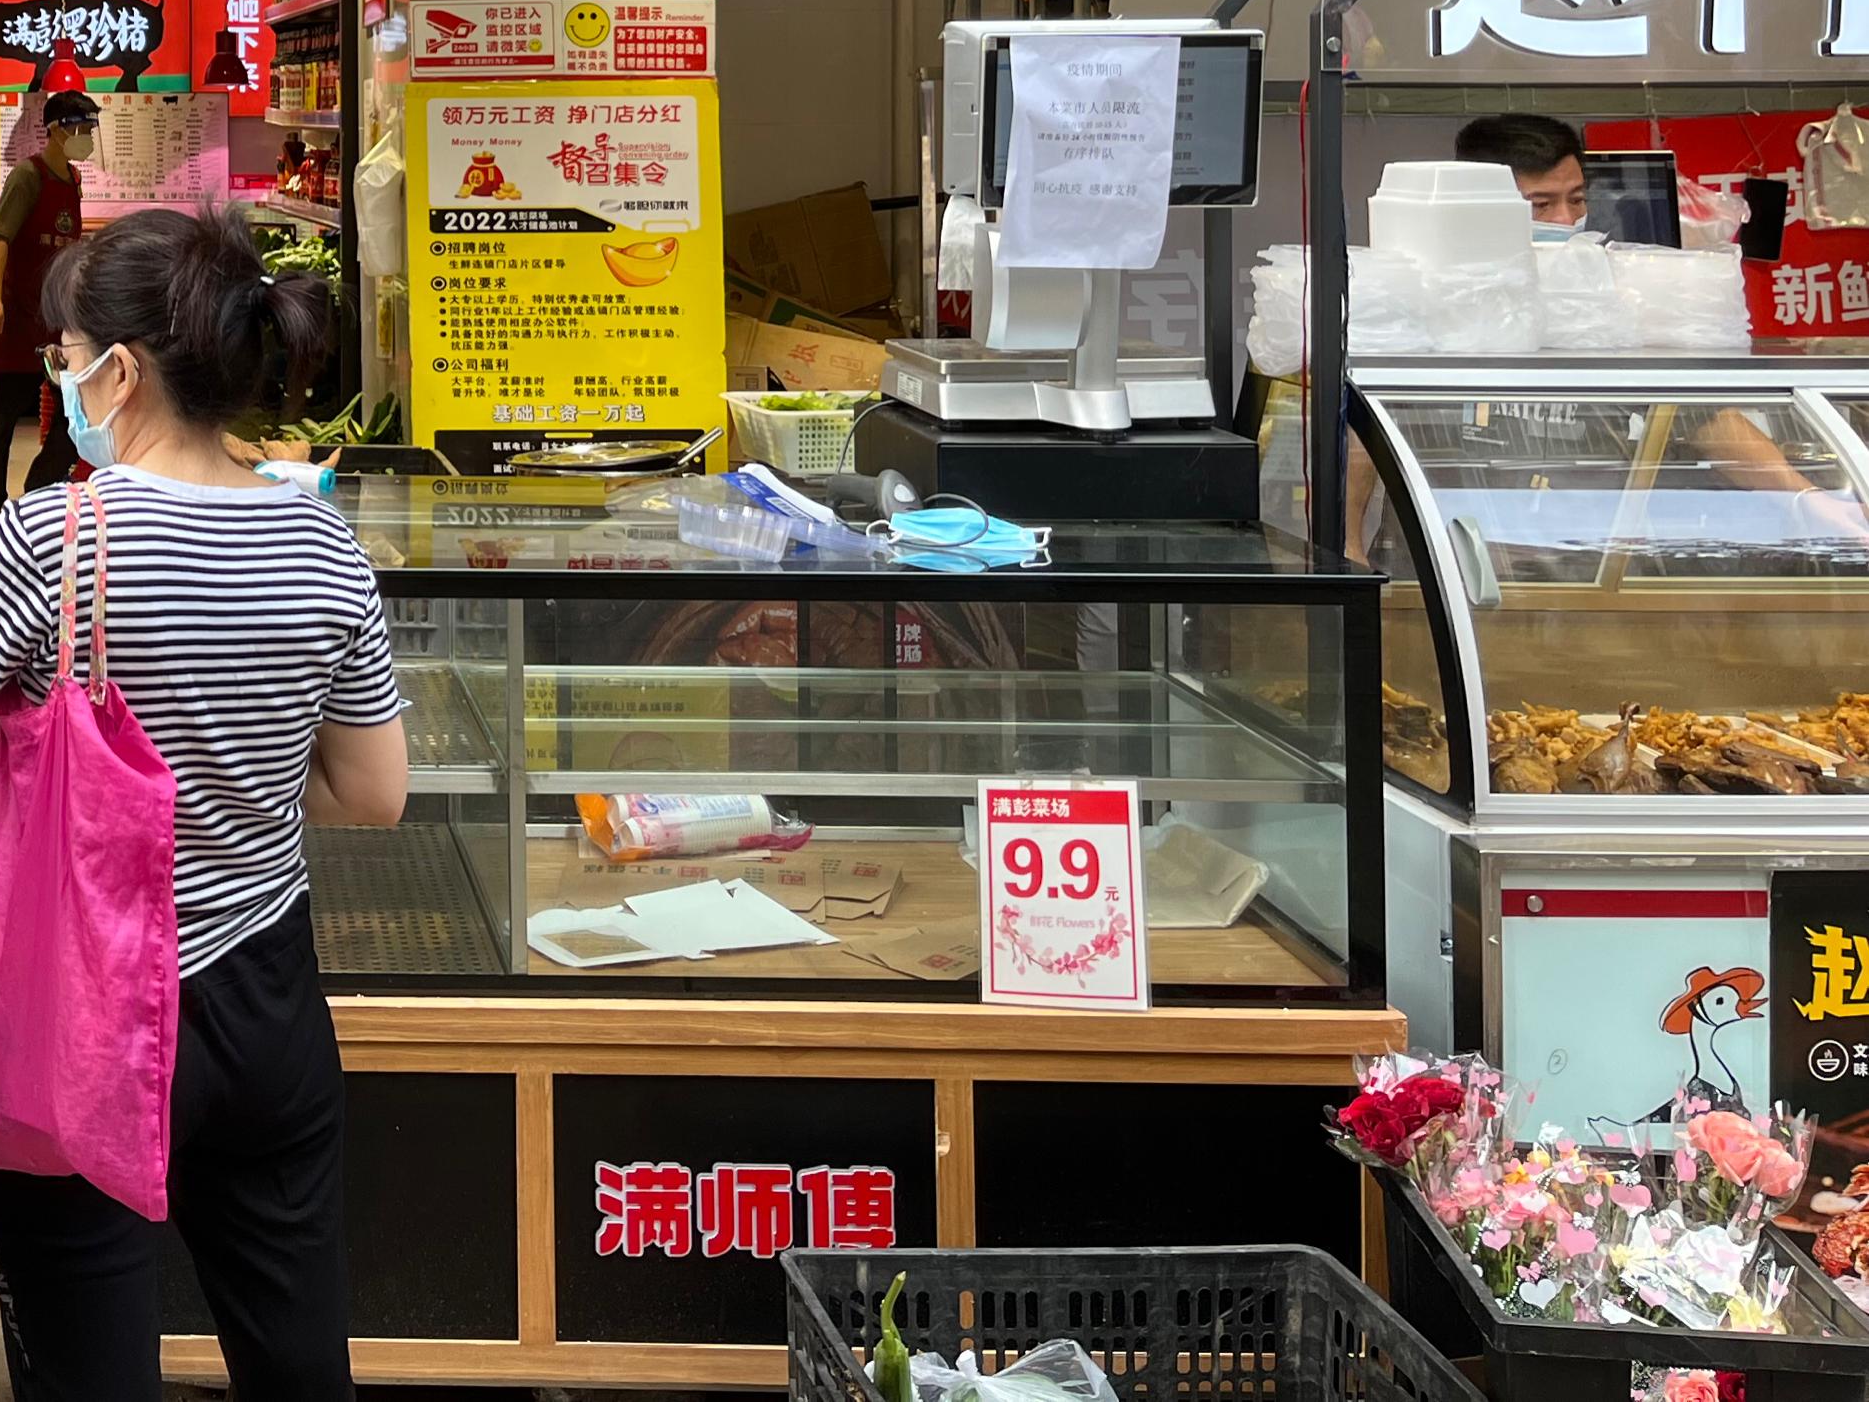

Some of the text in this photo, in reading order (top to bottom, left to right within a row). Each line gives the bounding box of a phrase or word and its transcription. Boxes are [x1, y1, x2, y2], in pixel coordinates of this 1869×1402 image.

[485, 7, 542, 20] 你已进入
[614, 6, 663, 20] 温馨提示
[485, 23, 543, 37] 监控区域
[485, 40, 529, 53] 请微笑
[567, 50, 608, 60] 如有遗失
[1066, 62, 1123, 77] 疫情期间
[1048, 100, 1141, 116] 本菜市人员限流
[442, 105, 682, 126] 领万元工资 挣门店分红
[451, 138, 523, 147] Money Money
[1063, 147, 1115, 161] 有序排队
[585, 162, 668, 186] 召集令
[1033, 181, 1139, 197] 同心抗疫 感谢支持
[443, 212, 508, 231] 2022
[447, 240, 507, 254] 招聘岗位
[449, 259, 567, 270] 生鲜连锁门店片区督导
[449, 276, 507, 290] 岗位要求
[451, 358, 510, 372] 公司福利
[492, 403, 646, 424] 基础工资一万起
[993, 797, 1070, 818] 满彭菜场
[1003, 838, 1119, 902] 9.9 元
[1056, 916, 1096, 929] Flowers
[596, 1160, 896, 1258] 满师傅
